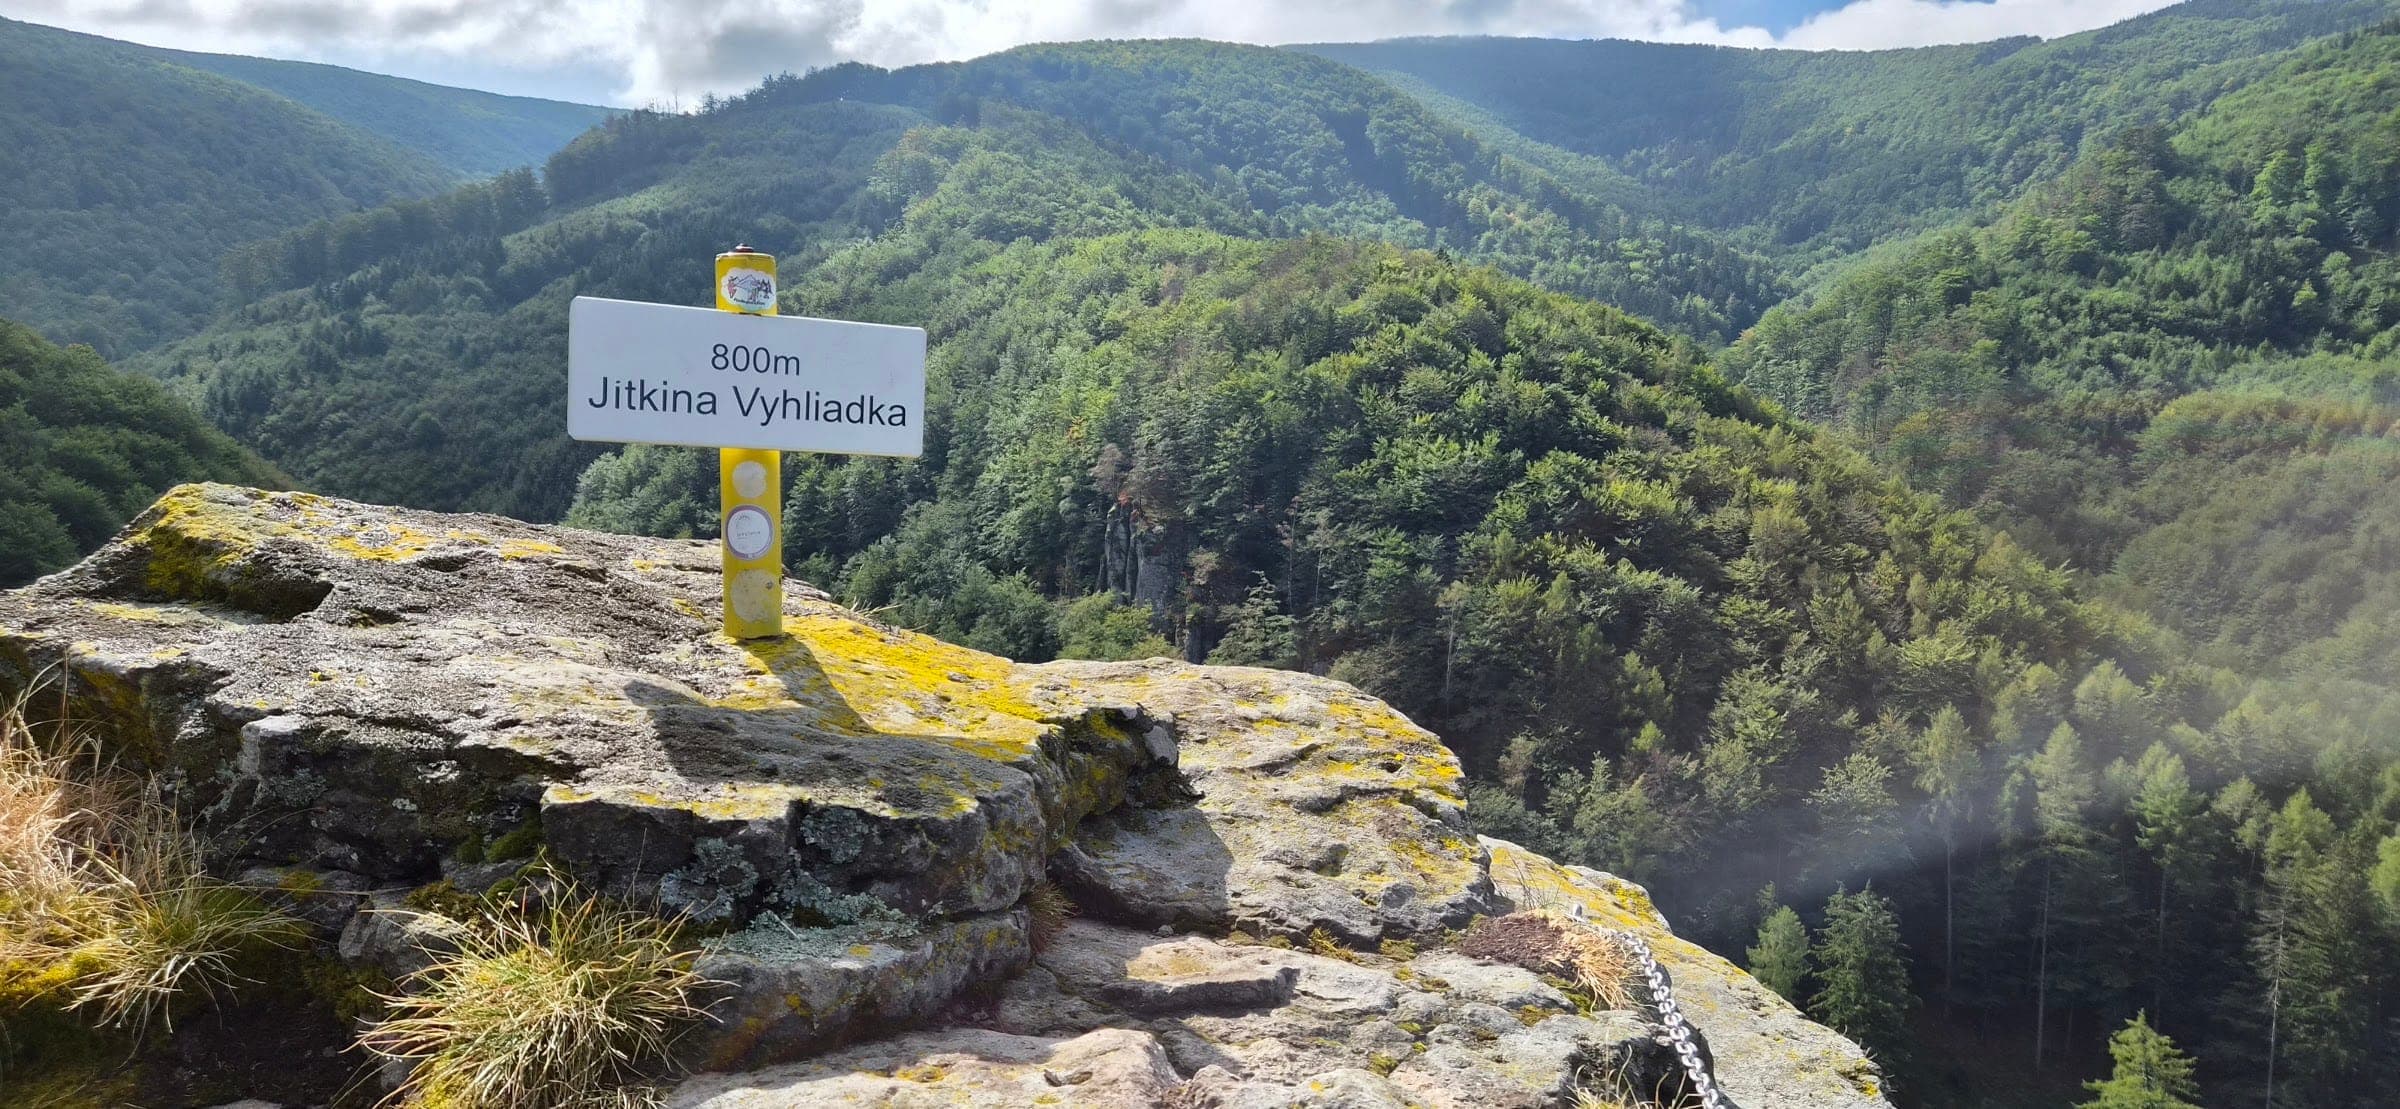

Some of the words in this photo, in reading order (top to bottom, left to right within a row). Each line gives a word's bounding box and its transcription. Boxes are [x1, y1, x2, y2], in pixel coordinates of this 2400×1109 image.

[710, 343, 801, 377] 800m
[588, 376, 717, 416] Jitkina
[732, 385, 907, 427] Vyhliadka
